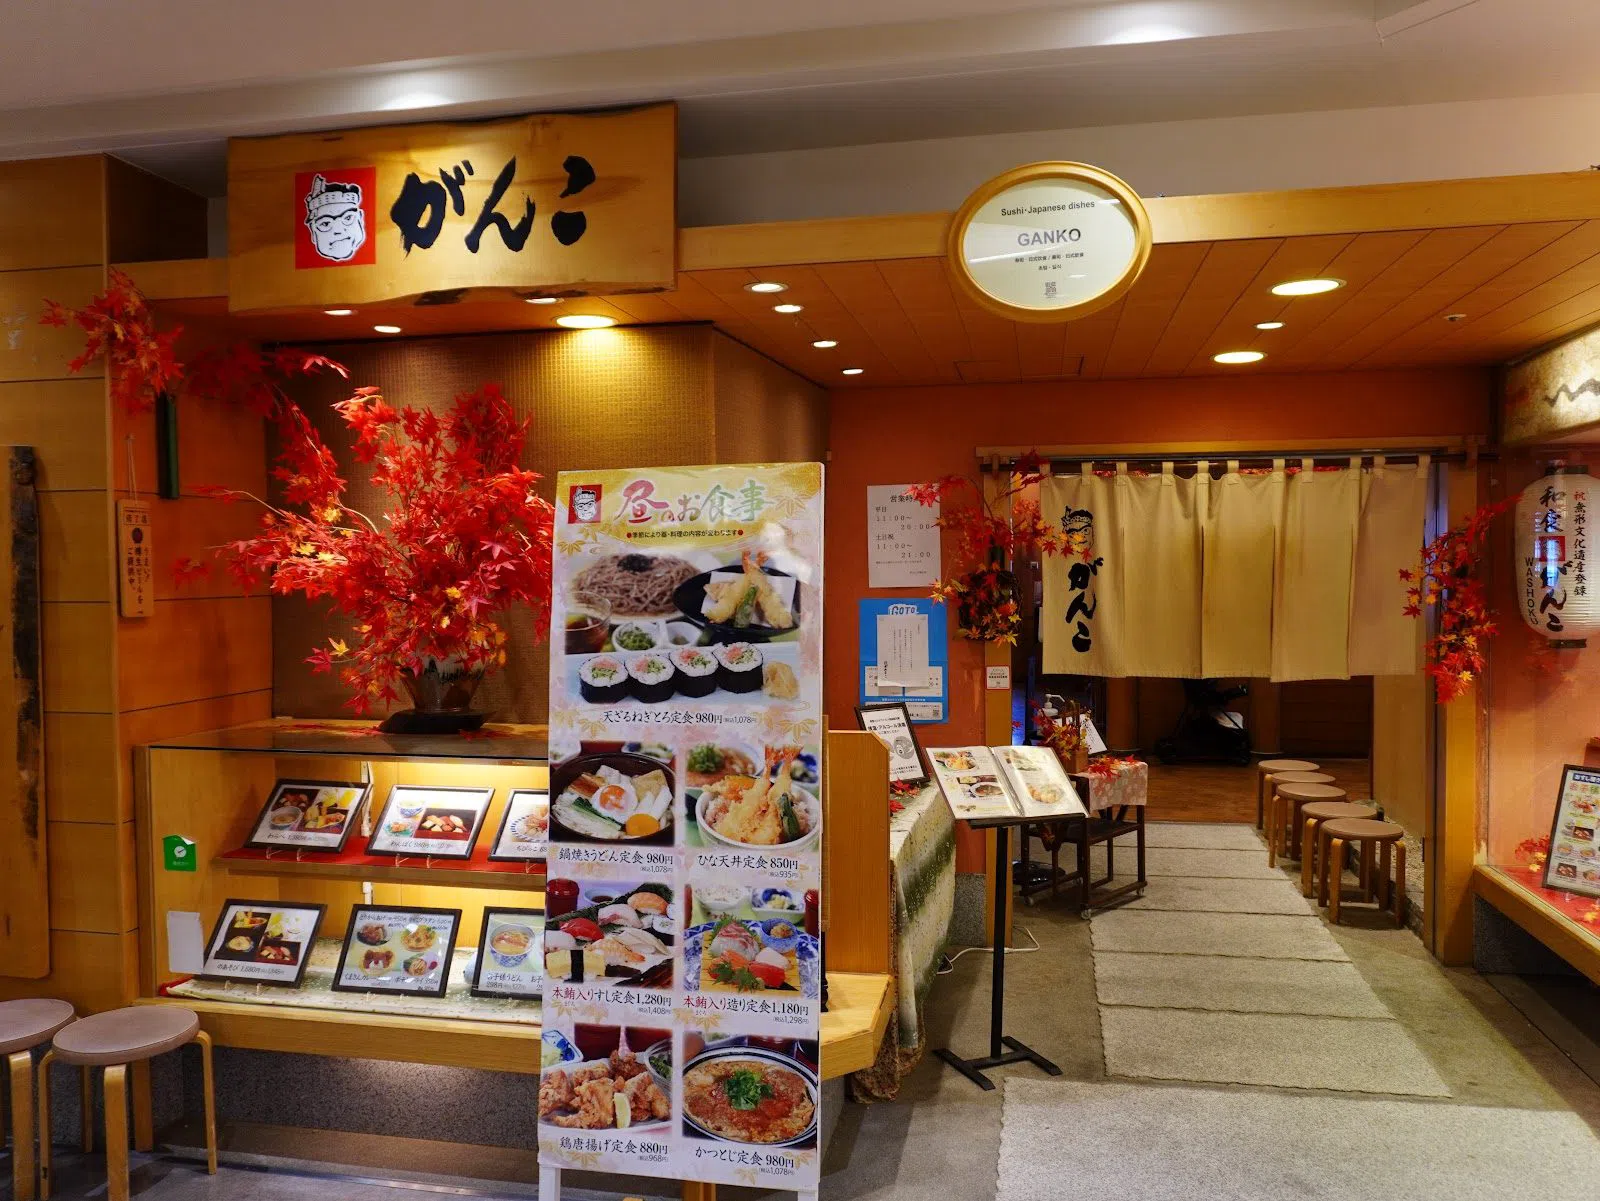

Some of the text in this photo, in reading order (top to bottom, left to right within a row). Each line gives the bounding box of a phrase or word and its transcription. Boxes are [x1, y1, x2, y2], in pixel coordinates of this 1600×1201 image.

[390, 155, 596, 259] がんこ
[1068, 201, 1095, 210] dishes
[1017, 228, 1082, 246] GANKO
[614, 479, 775, 523] 昼のお食事
[890, 494, 916, 503] 営業時
[1540, 486, 1567, 532] 和食
[1525, 557, 1539, 625] WASHOKU
[1065, 557, 1104, 653] がんこ
[603, 710, 694, 724] 天ざるねぎとろ定食
[695, 712, 723, 724] 980円
[559, 847, 673, 865] 鍋焼きうどん定食 980円
[769, 857, 798, 870] 850円
[552, 986, 672, 1006] 本鮪入りすし定食 1,280円
[683, 995, 809, 1015] 本鮪入り造り定食 1,180円
[560, 1136, 668, 1155] 鶏唐揚げ定食 880円
[695, 1146, 794, 1168] かつとじ定食 980円
